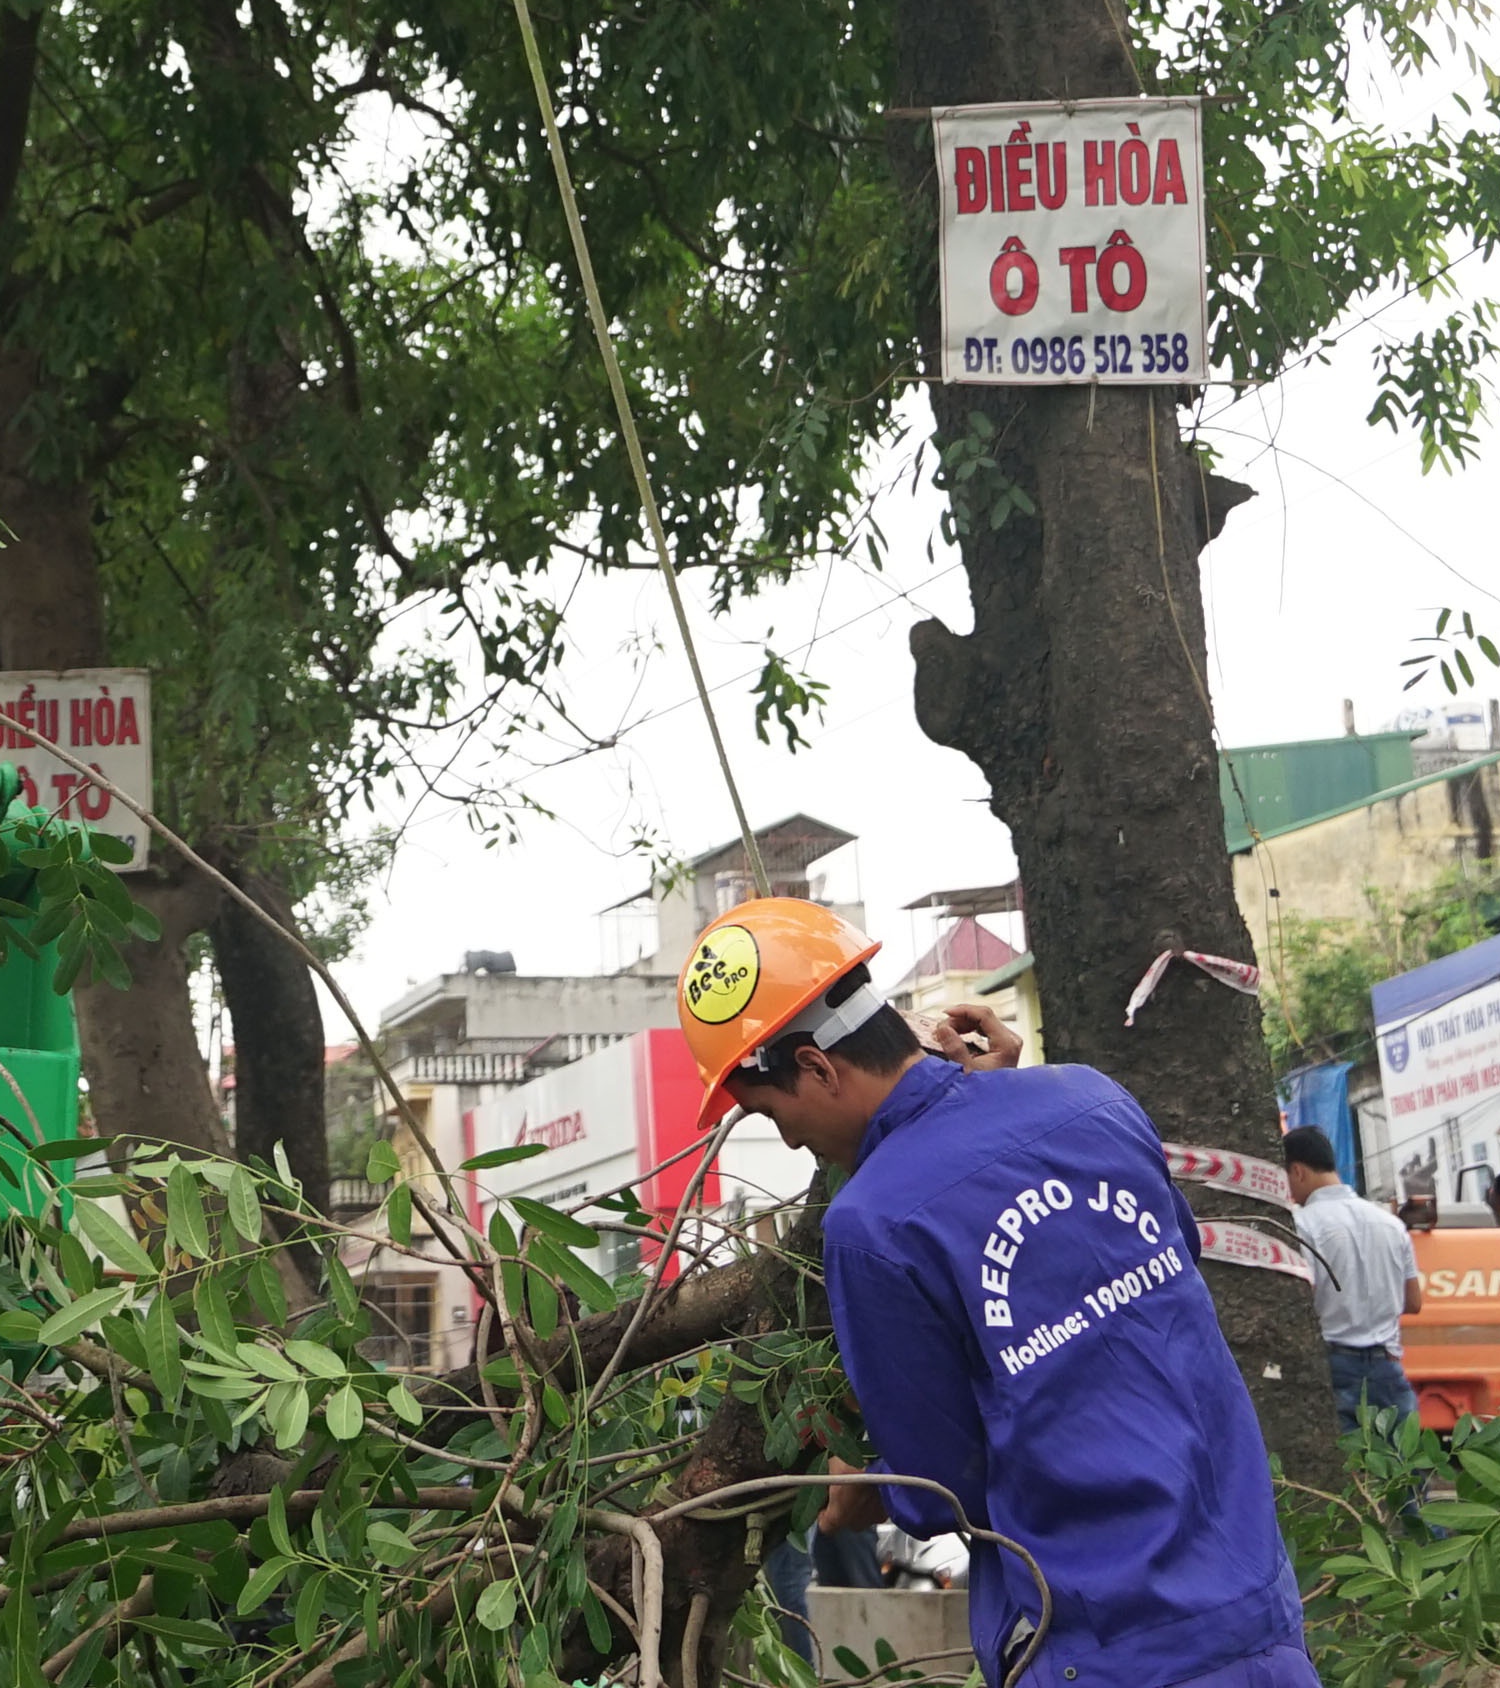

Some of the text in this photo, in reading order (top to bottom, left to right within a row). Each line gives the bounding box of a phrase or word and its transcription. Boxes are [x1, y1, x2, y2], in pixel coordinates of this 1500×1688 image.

[1083, 122, 1188, 207] HÒA
[989, 229, 1147, 317] Ô TÔ
[964, 332, 1189, 375] ĐT: 0986 512 358
[70, 686, 141, 746] HÒA
[52, 763, 112, 821] TÔ
[724, 967, 748, 989] PRO
[981, 1179, 1161, 1327] BEEPRO JSC
[999, 1246, 1183, 1376] Hotline: 19001918
